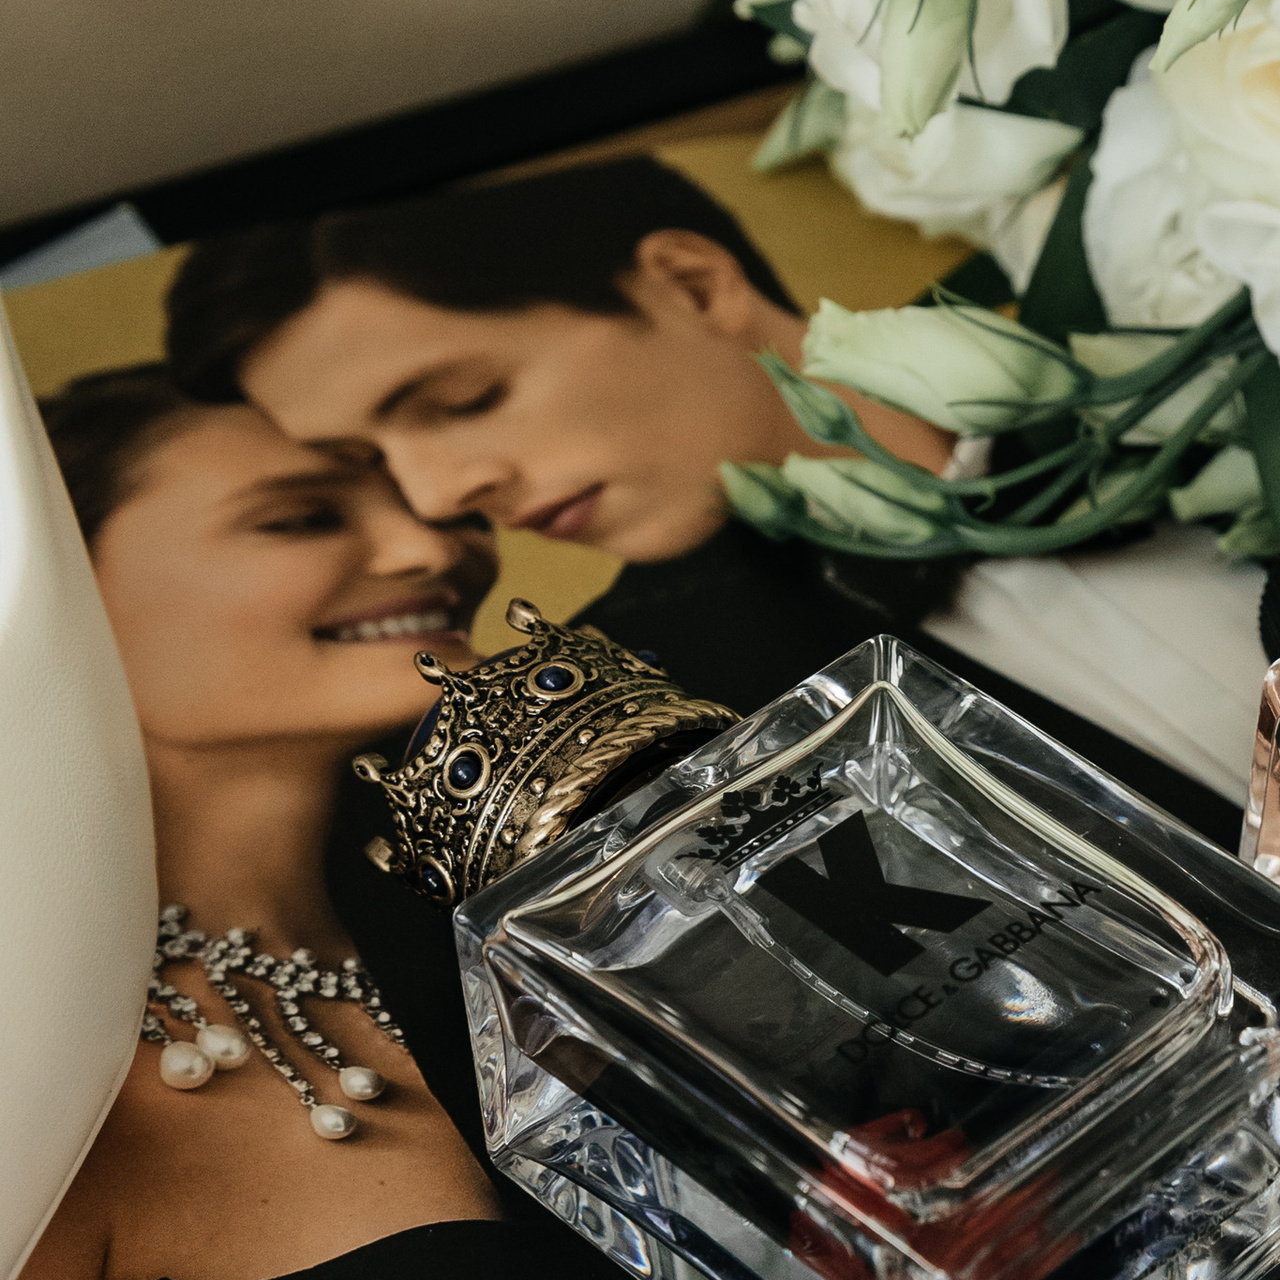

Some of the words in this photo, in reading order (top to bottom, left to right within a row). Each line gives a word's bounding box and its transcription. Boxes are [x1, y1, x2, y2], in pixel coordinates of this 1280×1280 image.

[754, 809, 994, 977] K
[837, 984, 944, 1065] DOLCE
[948, 880, 1103, 983] GABBANA
